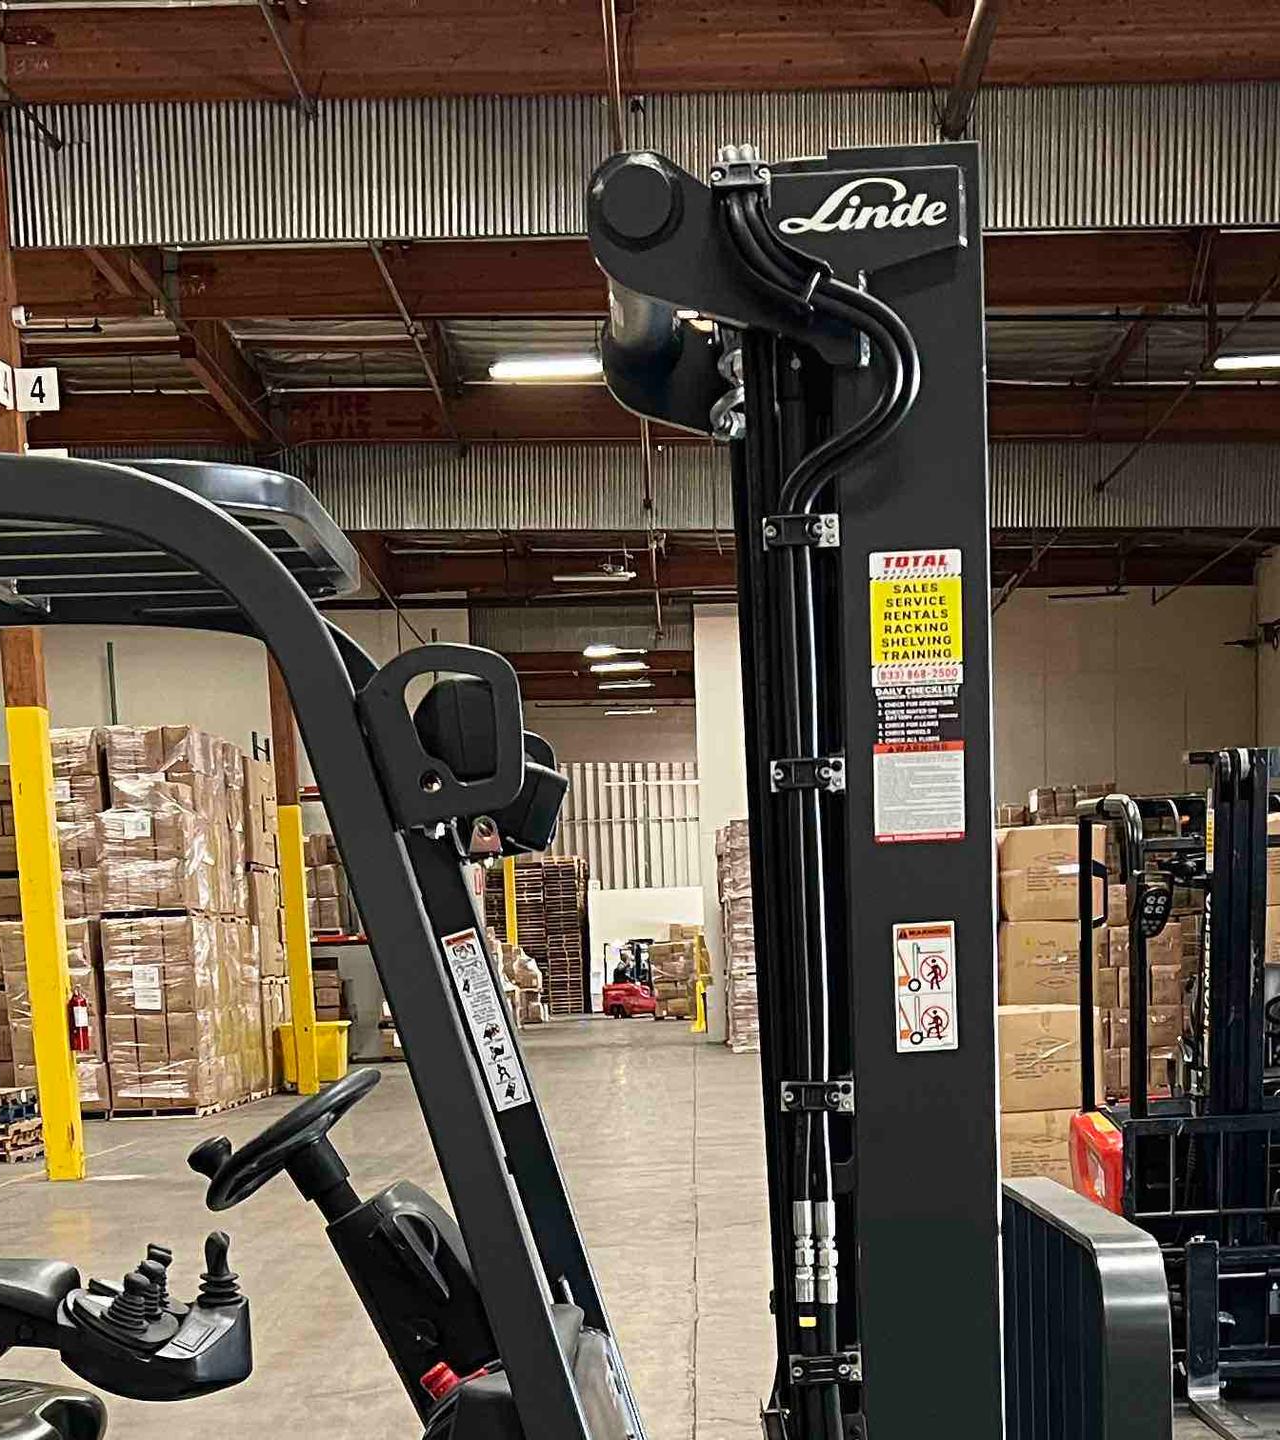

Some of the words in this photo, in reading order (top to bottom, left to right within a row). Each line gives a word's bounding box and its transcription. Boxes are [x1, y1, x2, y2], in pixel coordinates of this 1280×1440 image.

[778, 177, 948, 234] Linde
[30, 375, 46, 404] 4
[883, 554, 948, 569] TOTAL
[893, 583, 938, 594] SALES
[885, 596, 946, 608] SERVICE
[883, 609, 949, 621] RENTALS
[884, 622, 949, 634] RACKING
[881, 635, 952, 648] SHELVING
[881, 649, 952, 661] TRAINING
[875, 687, 904, 697] DAILY
[905, 684, 960, 695] CHECKLIST
